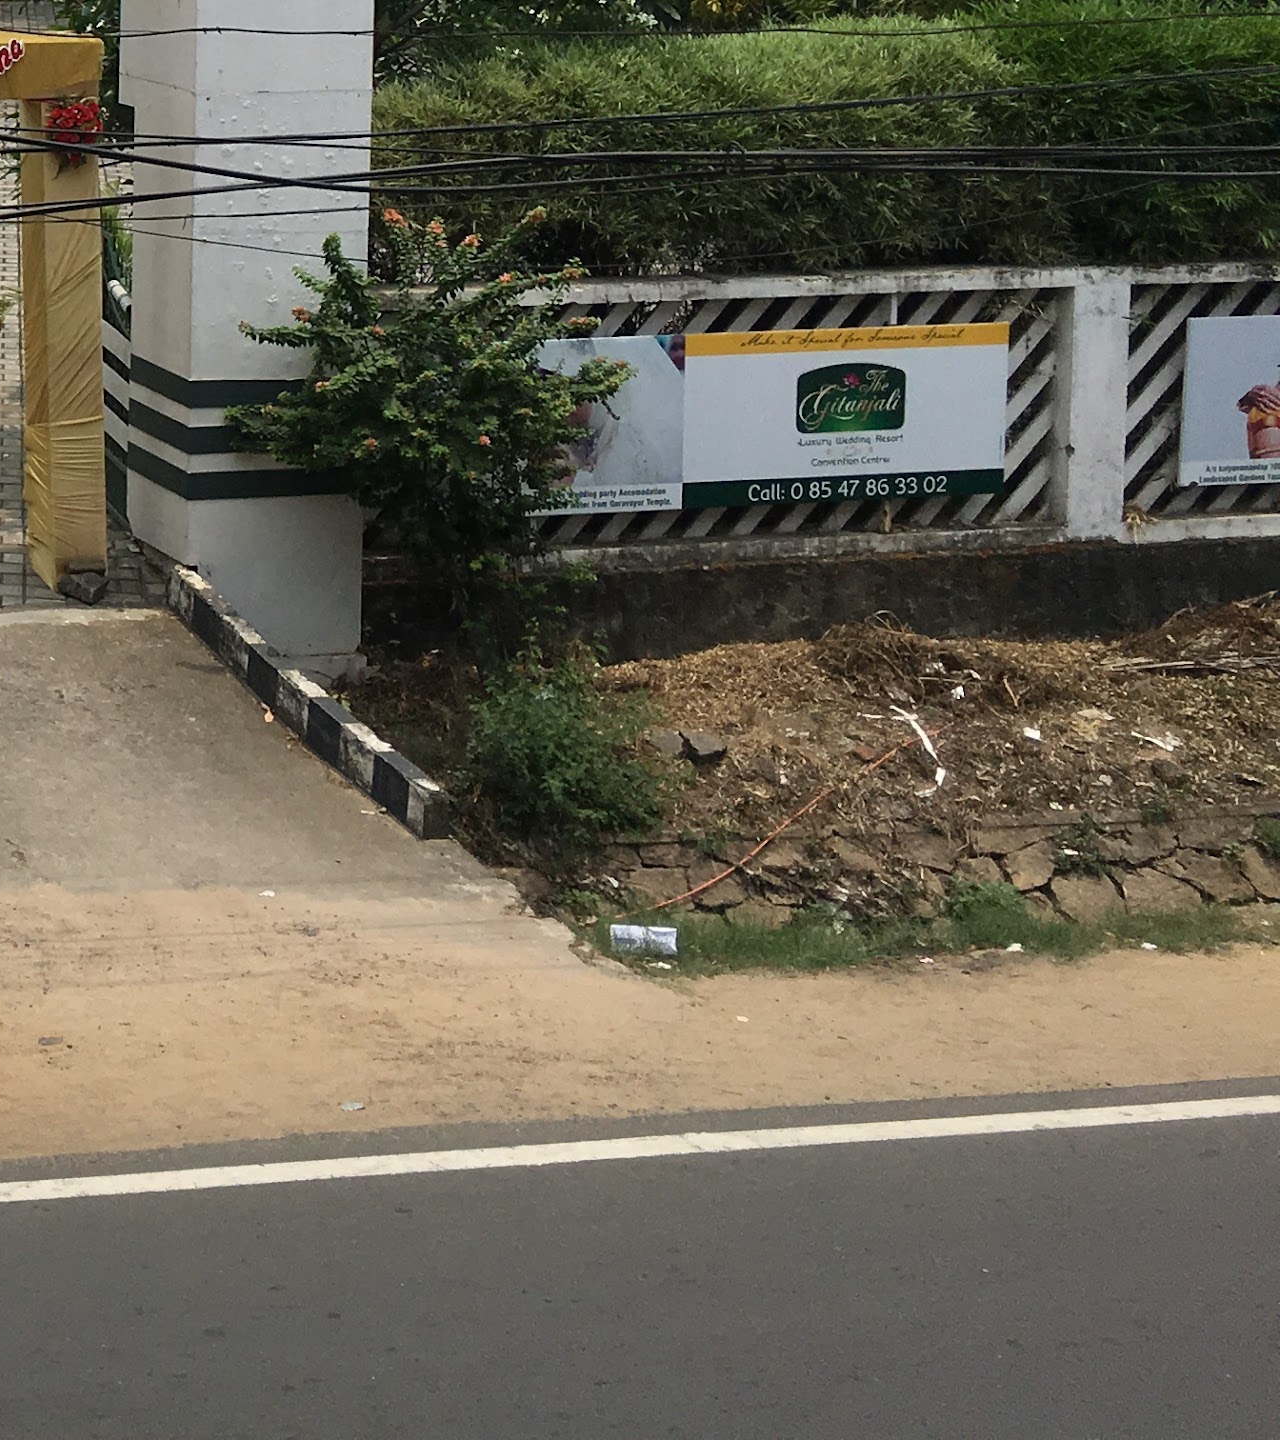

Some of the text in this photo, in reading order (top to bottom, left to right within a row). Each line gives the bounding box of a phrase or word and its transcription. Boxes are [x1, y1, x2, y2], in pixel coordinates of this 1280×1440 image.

[859, 369, 889, 392] The
[799, 384, 902, 431] Gitanjali
[798, 434, 903, 447] Luxury Wedding Resort
[811, 458, 859, 467] Convention
[748, 476, 948, 502] Call: 0 85 47 86 33 02
